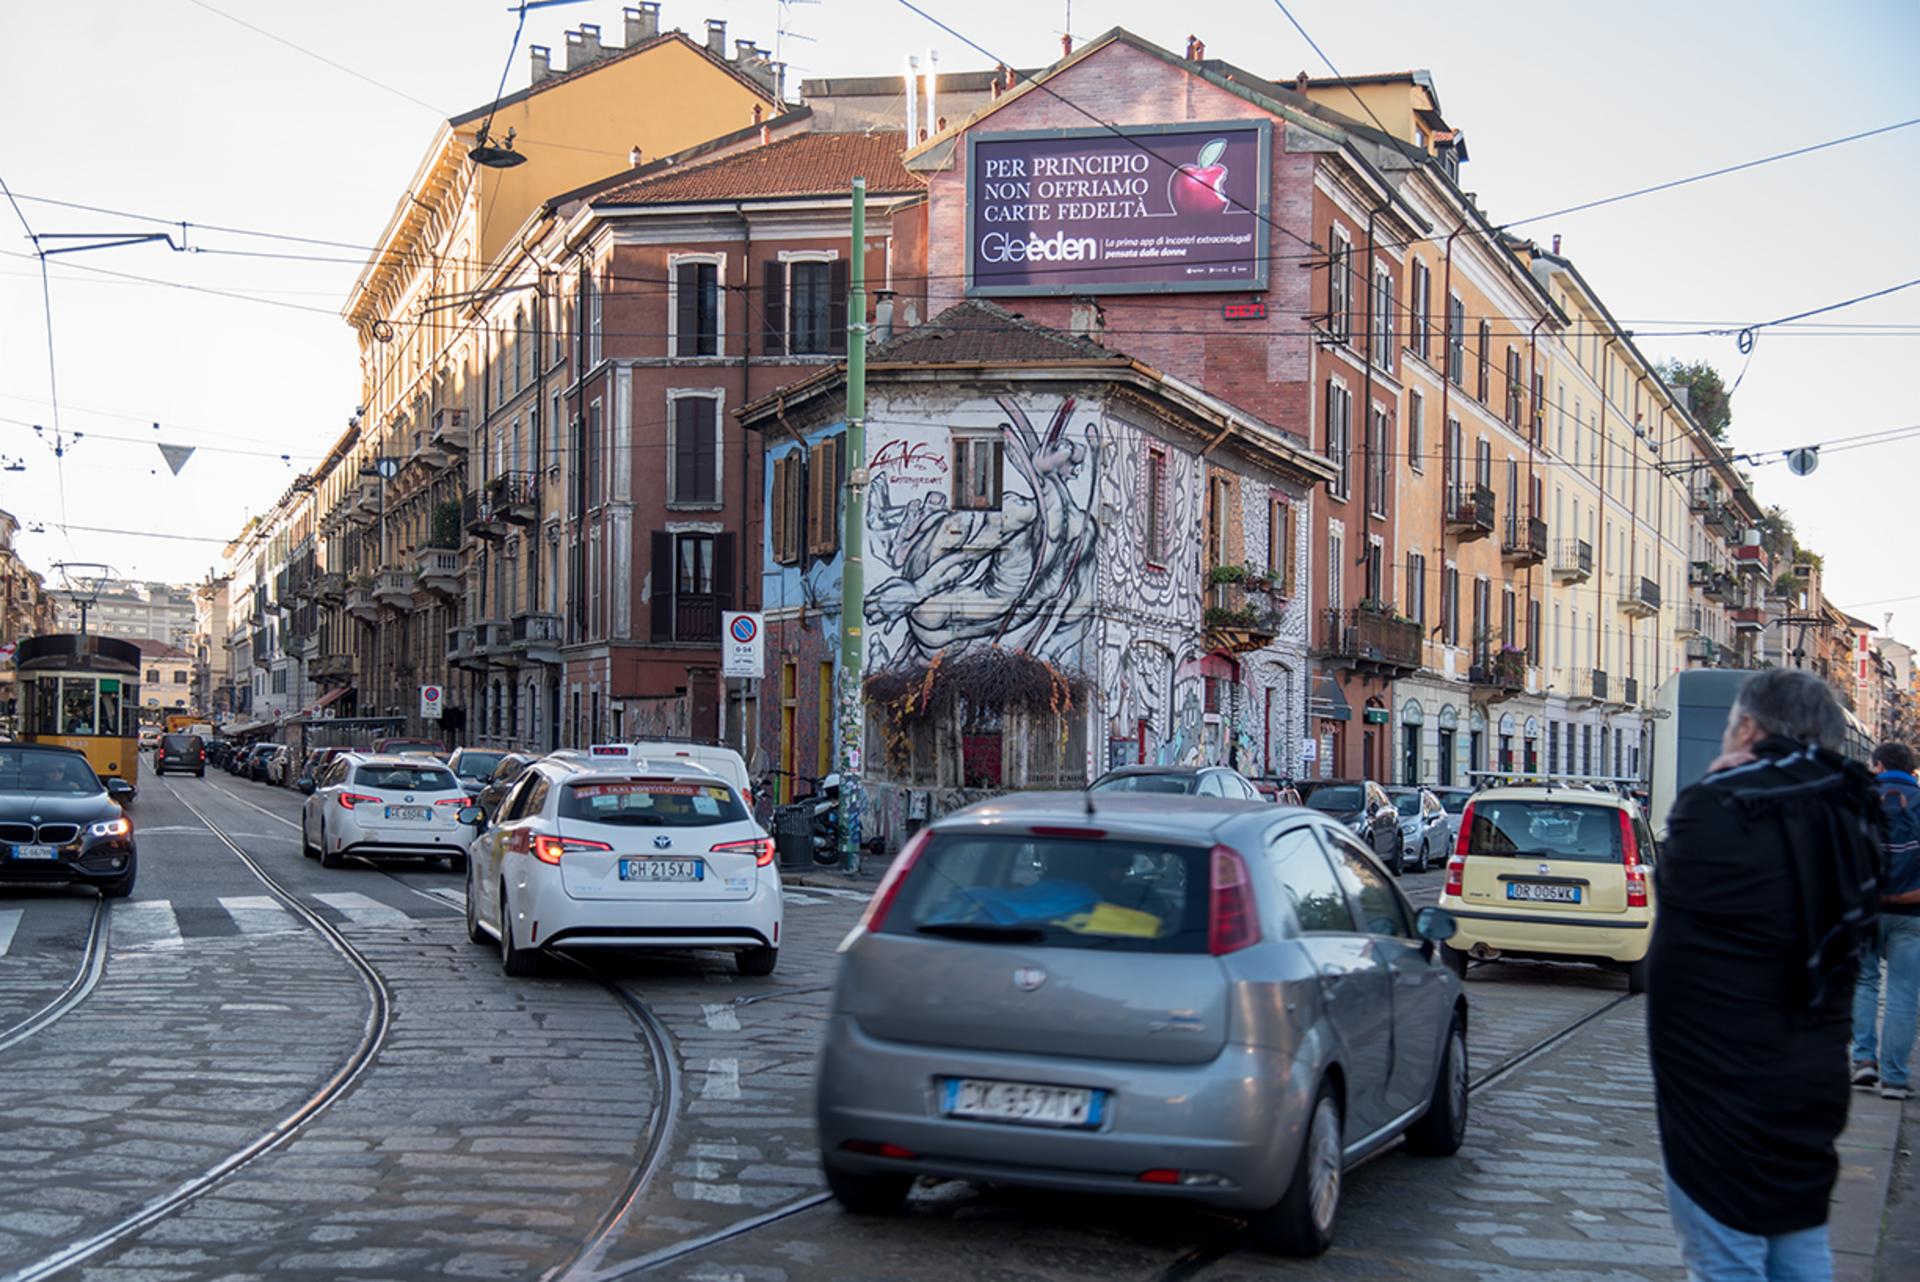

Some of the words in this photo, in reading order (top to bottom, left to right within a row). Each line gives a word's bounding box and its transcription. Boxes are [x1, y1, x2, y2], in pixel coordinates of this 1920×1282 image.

[985, 158, 1026, 178] PER
[1032, 154, 1150, 177] PRINCIPIO
[984, 181, 1031, 201] NON
[1038, 178, 1149, 200] OFFRIAMO
[984, 203, 1051, 222] CARTE
[1057, 197, 1148, 220] FEDELTÀ
[1105, 238, 1115, 247] La
[1116, 237, 1139, 248] prima
[1140, 238, 1155, 248] app
[1156, 236, 1164, 245] di
[1165, 234, 1196, 245] incontri
[1196, 233, 1252, 245] extraconiugali
[1105, 248, 1138, 260] pensata
[1139, 248, 1159, 258] dalle
[1160, 247, 1187, 257] donne
[629, 862, 646, 876] GH
[651, 862, 694, 876] 215XJ
[1515, 884, 1531, 897] DR
